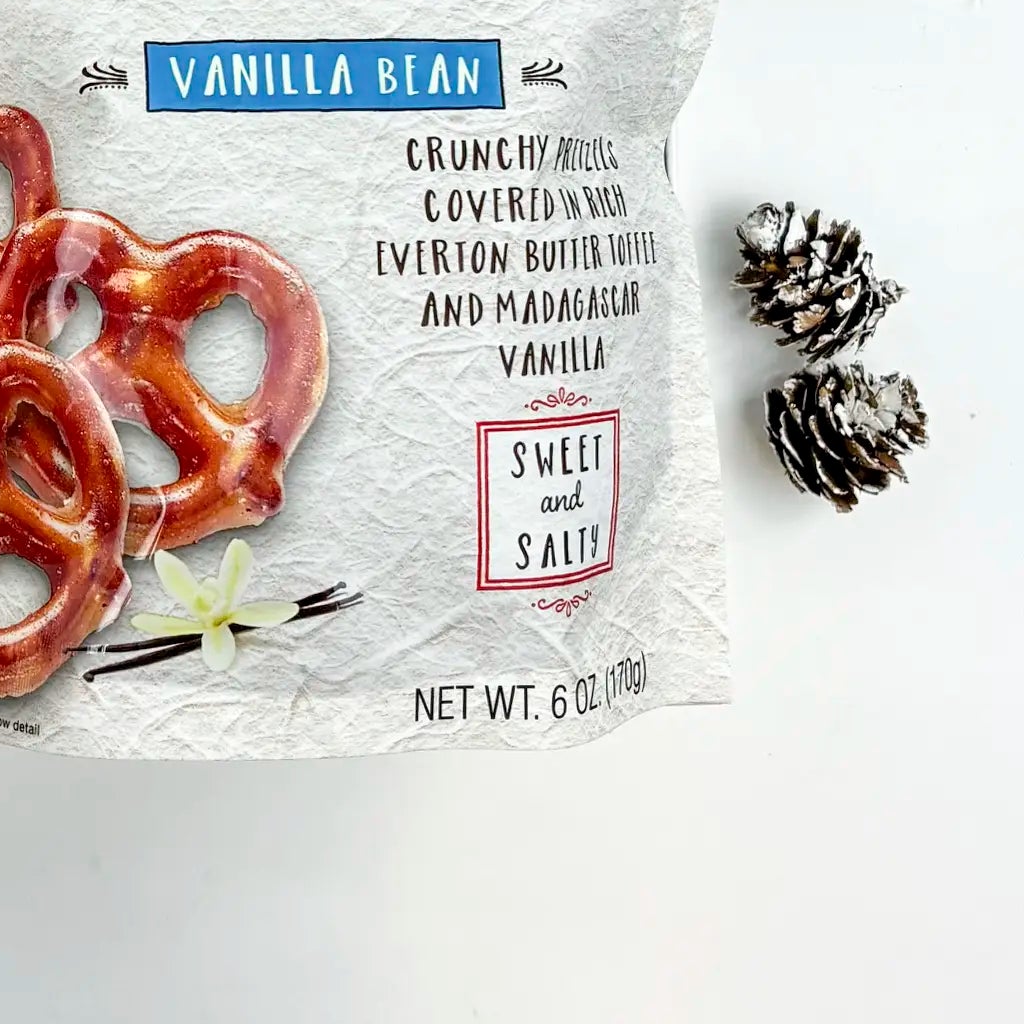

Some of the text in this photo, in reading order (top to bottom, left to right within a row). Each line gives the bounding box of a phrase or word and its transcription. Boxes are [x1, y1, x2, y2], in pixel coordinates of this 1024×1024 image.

[169, 53, 480, 98] VANILLA BEAN
[406, 135, 619, 172] CRUNCHY PRETZELS
[425, 184, 628, 223] COVERED IN RICH
[377, 231, 658, 276] EVERTON BUTTER TOFFEE
[421, 281, 640, 327] AND MADAGASCAR
[499, 336, 605, 378] VANILLA
[511, 434, 602, 478] SWEET
[541, 480, 584, 513] and
[515, 524, 599, 570] SALTY
[415, 651, 647, 721] NET WT. 6 OZ. (170g)
[13, 720, 40, 736] detail
